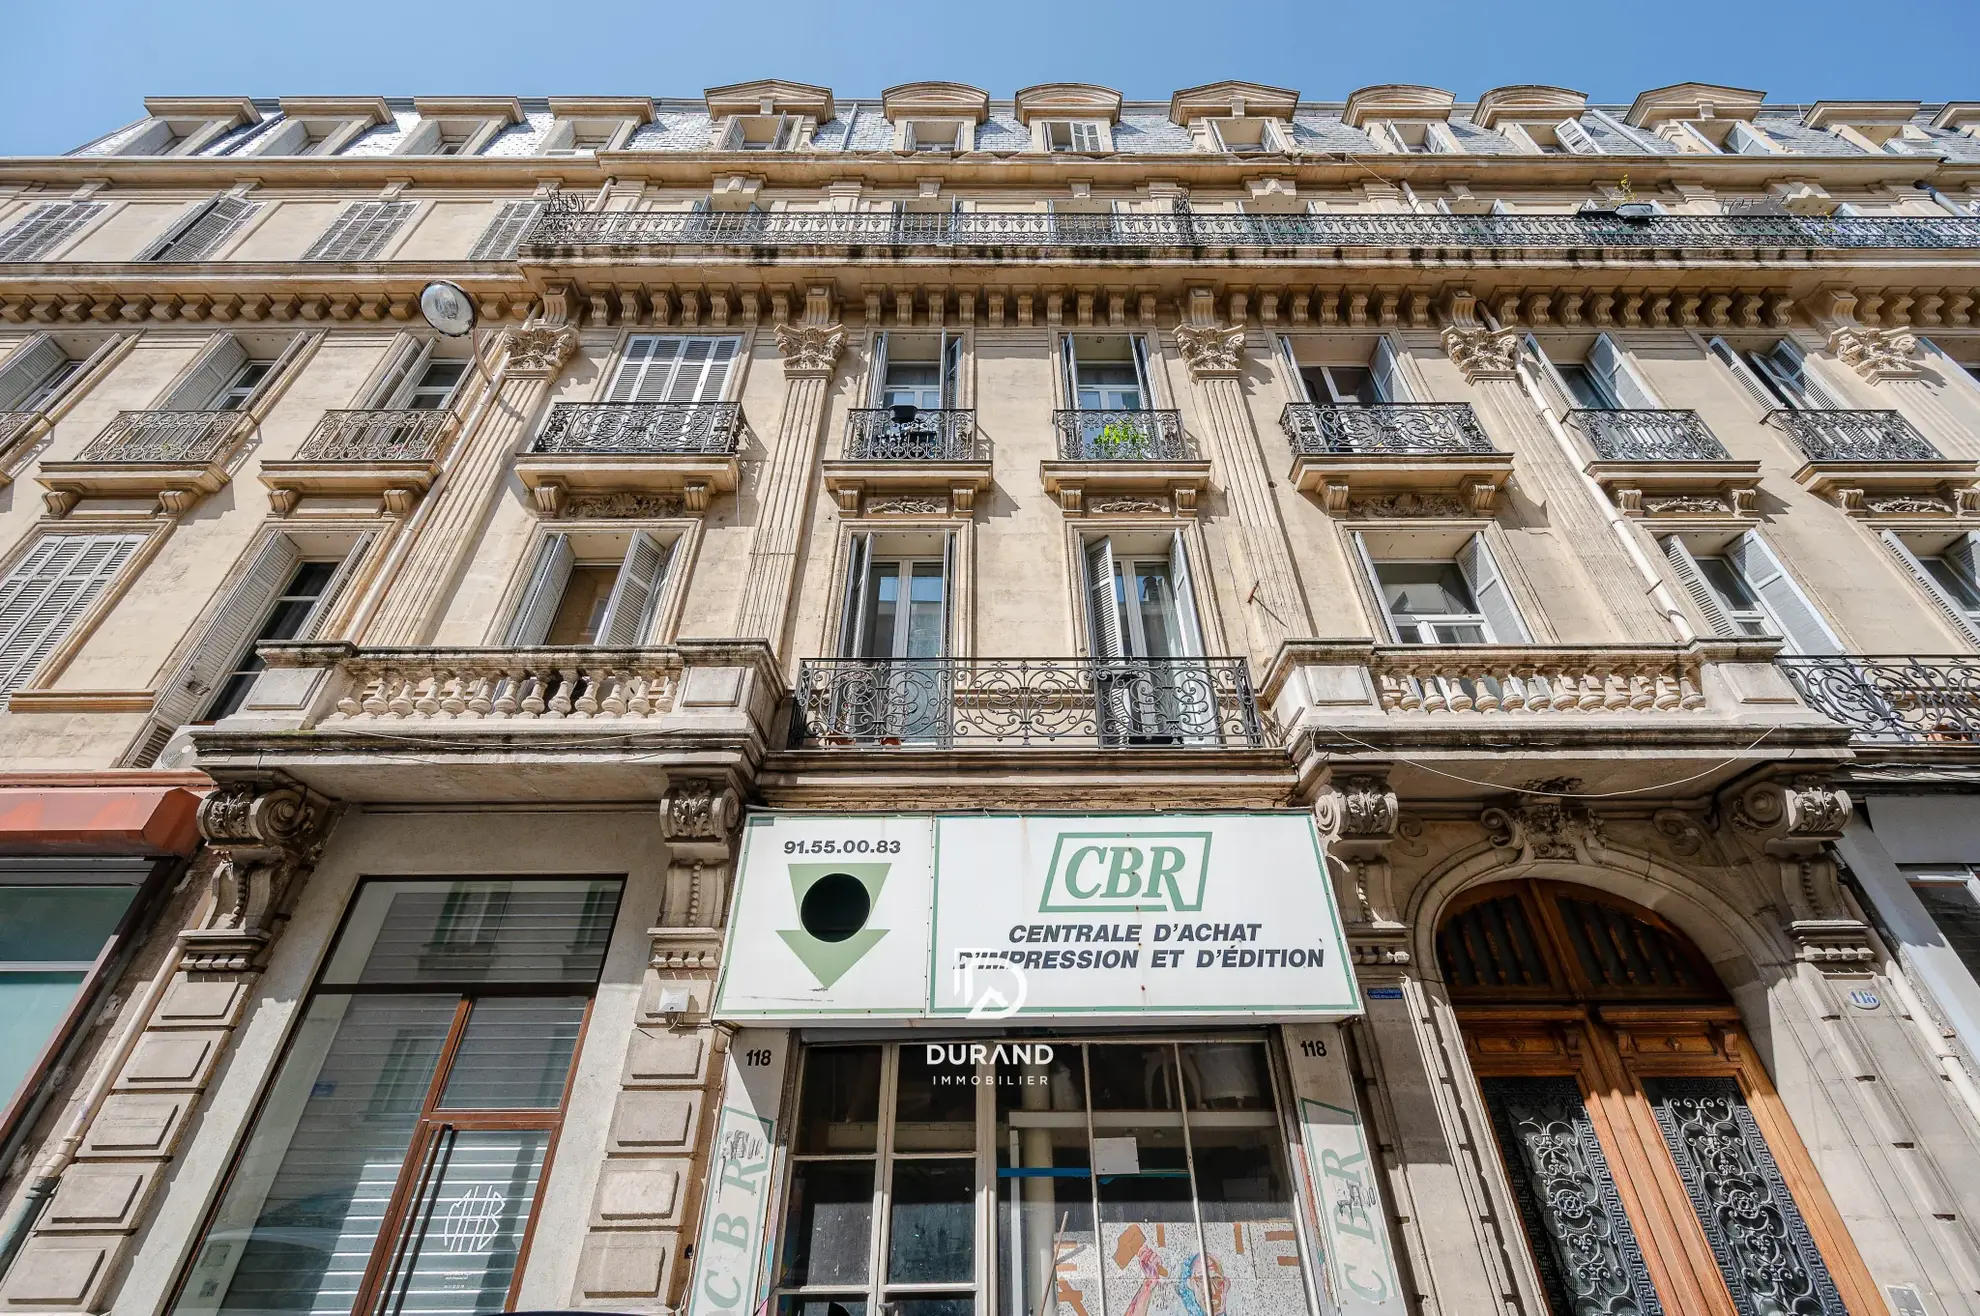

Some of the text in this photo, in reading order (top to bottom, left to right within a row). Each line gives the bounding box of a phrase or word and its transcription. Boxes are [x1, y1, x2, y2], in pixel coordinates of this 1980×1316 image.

[784, 840, 901, 854] 91.55.00.83
[1065, 846, 1186, 911] CBR
[1009, 924, 1262, 943] CENTRALE D'ACHAT
[1151, 950, 1184, 968] ET
[1196, 945, 1325, 968] D'ÉDITION
[746, 1049, 772, 1066] 118
[1300, 1040, 1327, 1057] 118
[704, 1158, 768, 1309] CBR
[1321, 1148, 1388, 1305] CBR
